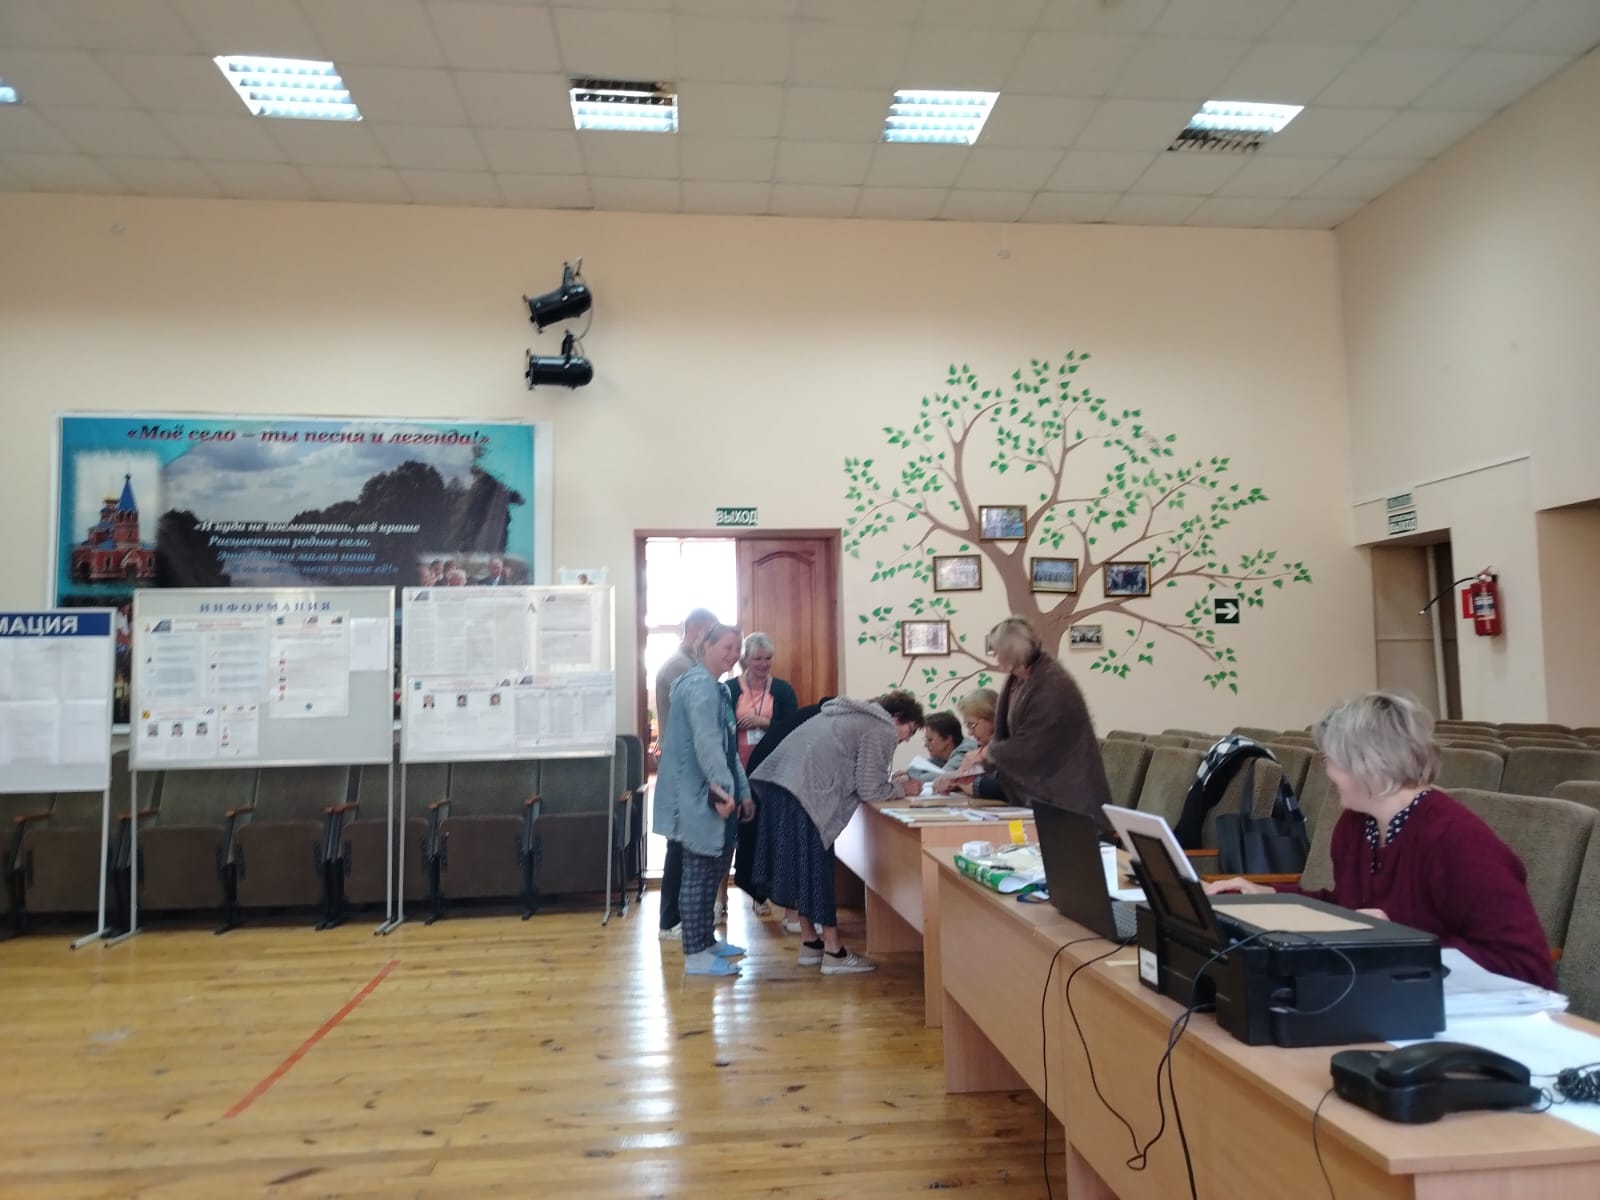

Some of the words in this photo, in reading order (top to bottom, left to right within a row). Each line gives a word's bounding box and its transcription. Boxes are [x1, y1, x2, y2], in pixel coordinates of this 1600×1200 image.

[127, 423, 185, 441] «Моё
[189, 430, 237, 442] село
[261, 430, 299, 443] ты
[304, 431, 365, 444] песня
[370, 431, 384, 444] и
[387, 429, 490, 446] легенда!»
[716, 509, 757, 525] ВЫХОД
